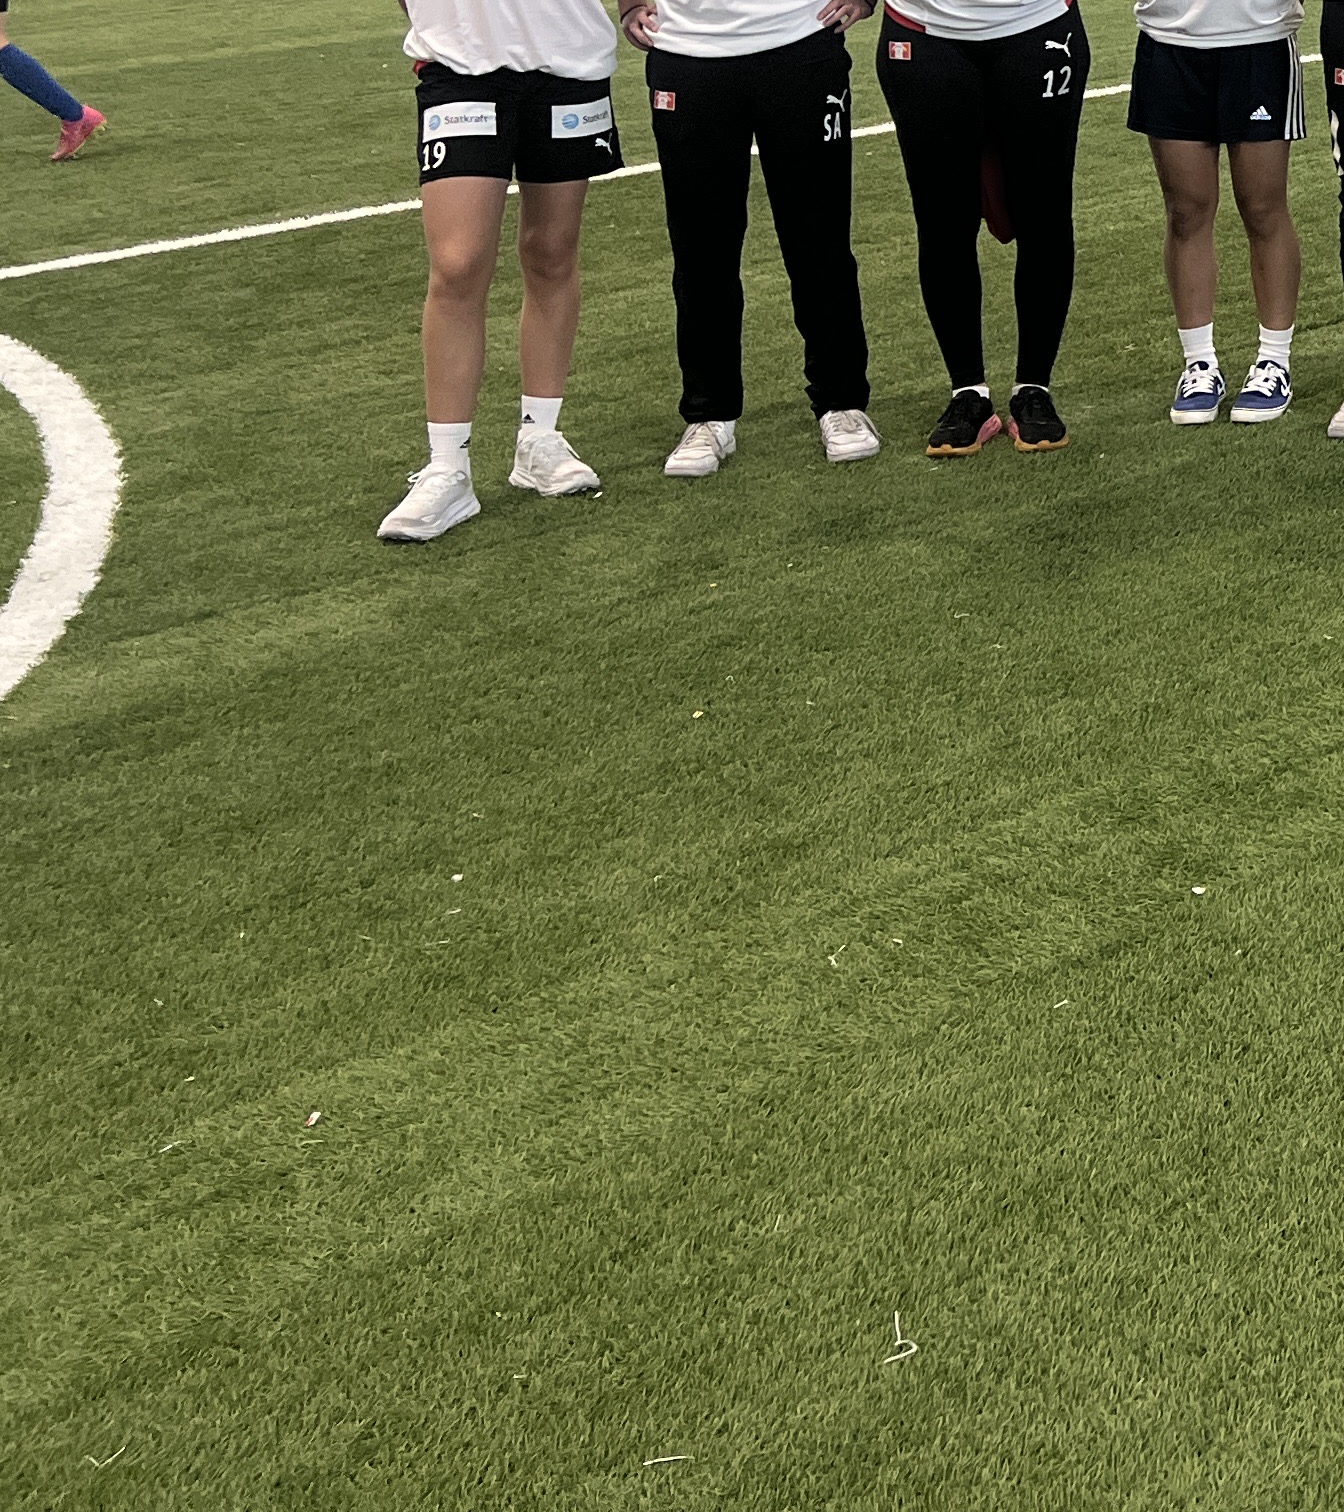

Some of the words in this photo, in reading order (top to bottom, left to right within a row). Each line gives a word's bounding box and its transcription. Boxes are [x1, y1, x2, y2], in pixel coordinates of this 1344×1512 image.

[1042, 65, 1072, 98] 12
[444, 114, 489, 125] Statkraft
[824, 112, 841, 141] SA
[421, 141, 446, 172] 19
